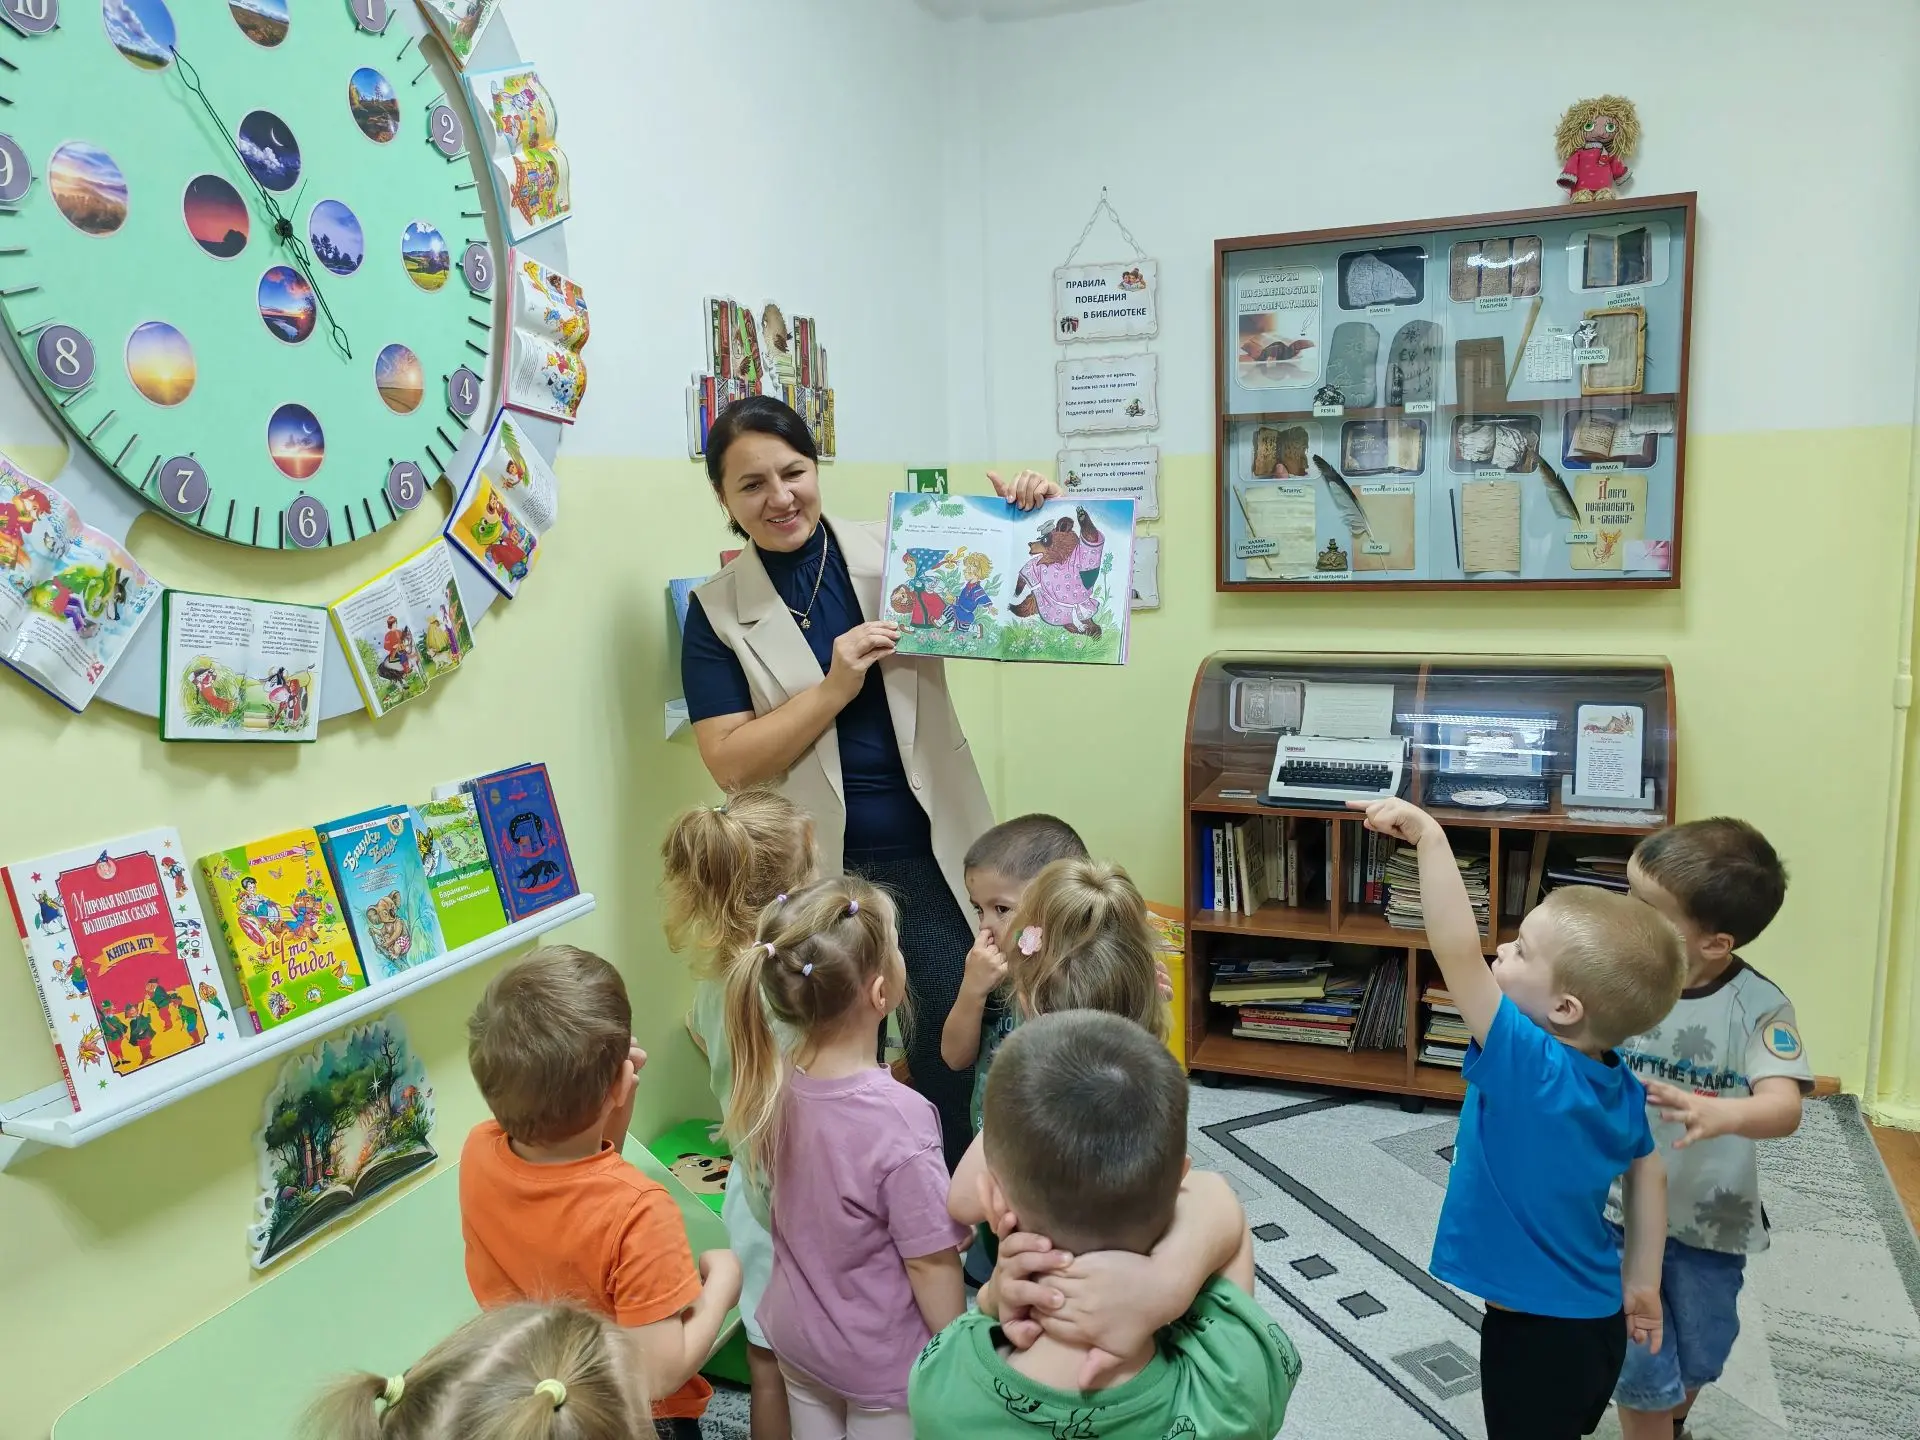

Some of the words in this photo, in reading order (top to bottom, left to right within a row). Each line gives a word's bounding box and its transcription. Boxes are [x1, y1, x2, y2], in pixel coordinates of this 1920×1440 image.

[441, 114, 455, 144] 2
[475, 254, 487, 282] 3
[1066, 279, 1106, 289] ПРАВИЛА
[1240, 286, 1309, 298] ПИСЬМЕННОСТИ
[1075, 293, 1127, 304] ПОВЕДЕНИЯ
[1090, 308, 1147, 318] БИБЛИОТЕКЕ
[55, 337, 80, 376] 8
[460, 378, 473, 404] 4
[176, 469, 194, 504] 7
[400, 472, 414, 500] 5
[299, 506, 317, 538] 6
[114, 883, 159, 907] КОЛЛЕКЦИЯ
[439, 885, 471, 898] Баранкин,
[441, 899, 457, 908] будь
[457, 885, 490, 902] человеком!
[82, 908, 132, 935] ВОЛШЕБНЫХ
[131, 902, 159, 921] СКАЗОК
[106, 941, 137, 961] КНИГА
[137, 938, 154, 951] ИГР
[263, 931, 308, 965] Что
[28, 955, 41, 983] СКАЗКИ
[270, 970, 283, 988] я
[288, 949, 336, 980] видел
[65, 1071, 77, 1097] КНИГА
[1645, 1059, 1684, 1083] THE
[1690, 1070, 1735, 1090] LAND
